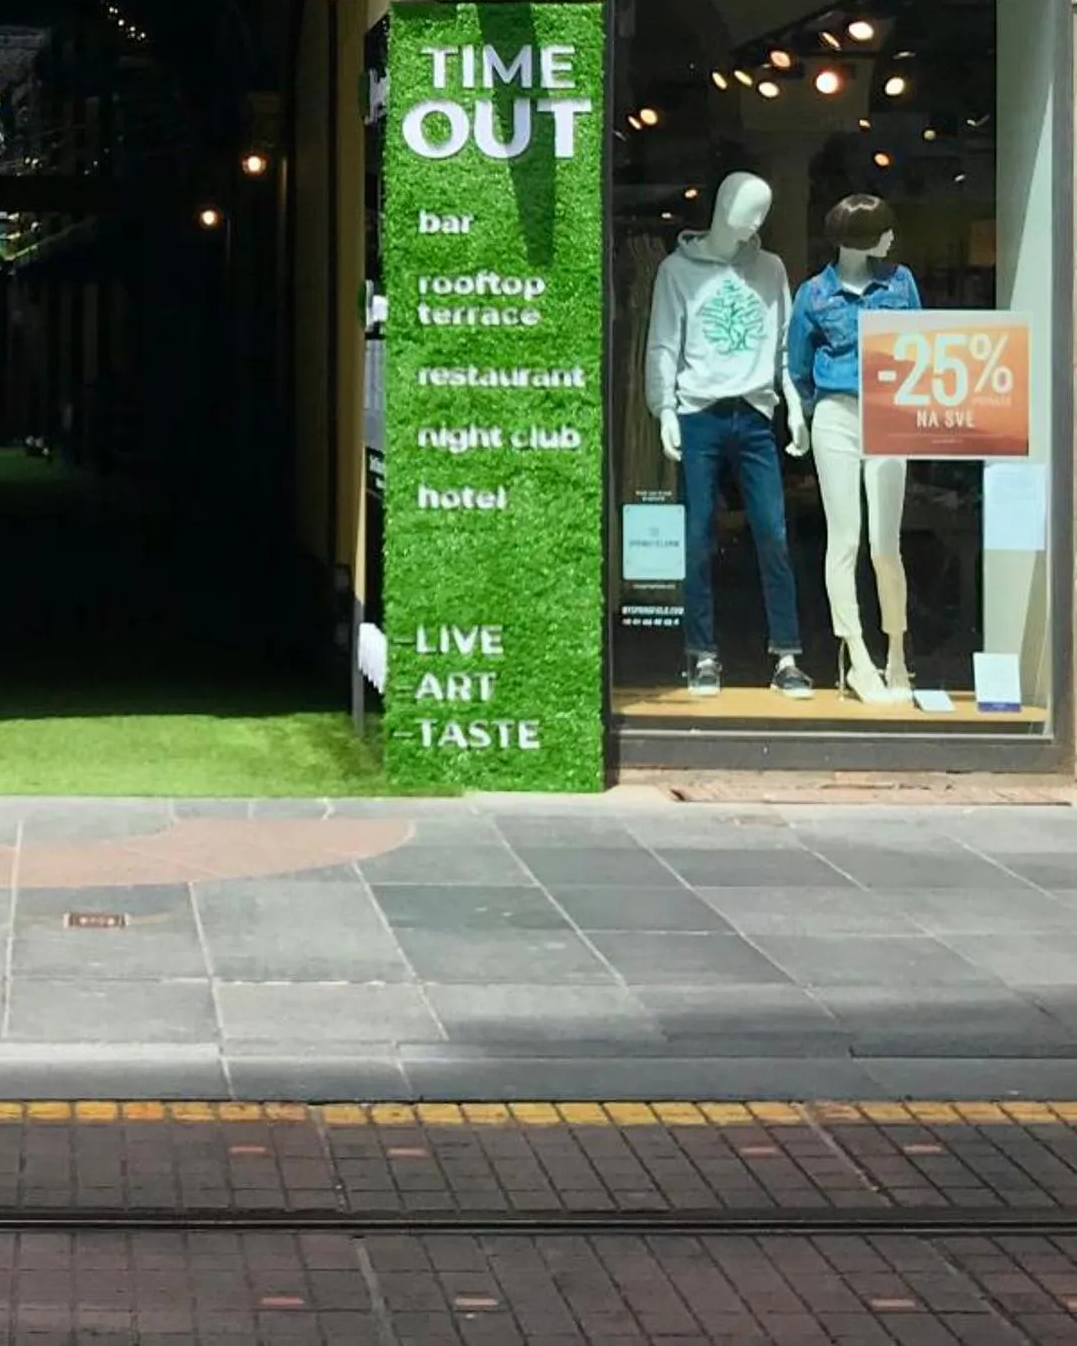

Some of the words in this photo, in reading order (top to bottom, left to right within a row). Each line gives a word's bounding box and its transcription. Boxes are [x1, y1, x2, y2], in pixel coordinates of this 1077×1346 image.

[422, 44, 576, 89] TIME
[402, 98, 592, 159] OUT
[418, 210, 474, 234] bar
[418, 271, 546, 298] rooftop
[418, 303, 541, 327] terrace
[418, 364, 586, 387] restaurant
[877, 332, 1014, 407] -25%
[916, 410, 939, 428] NA
[944, 410, 976, 428] SVE
[417, 424, 504, 453] night
[509, 424, 582, 449] club
[417, 484, 507, 510] hotel
